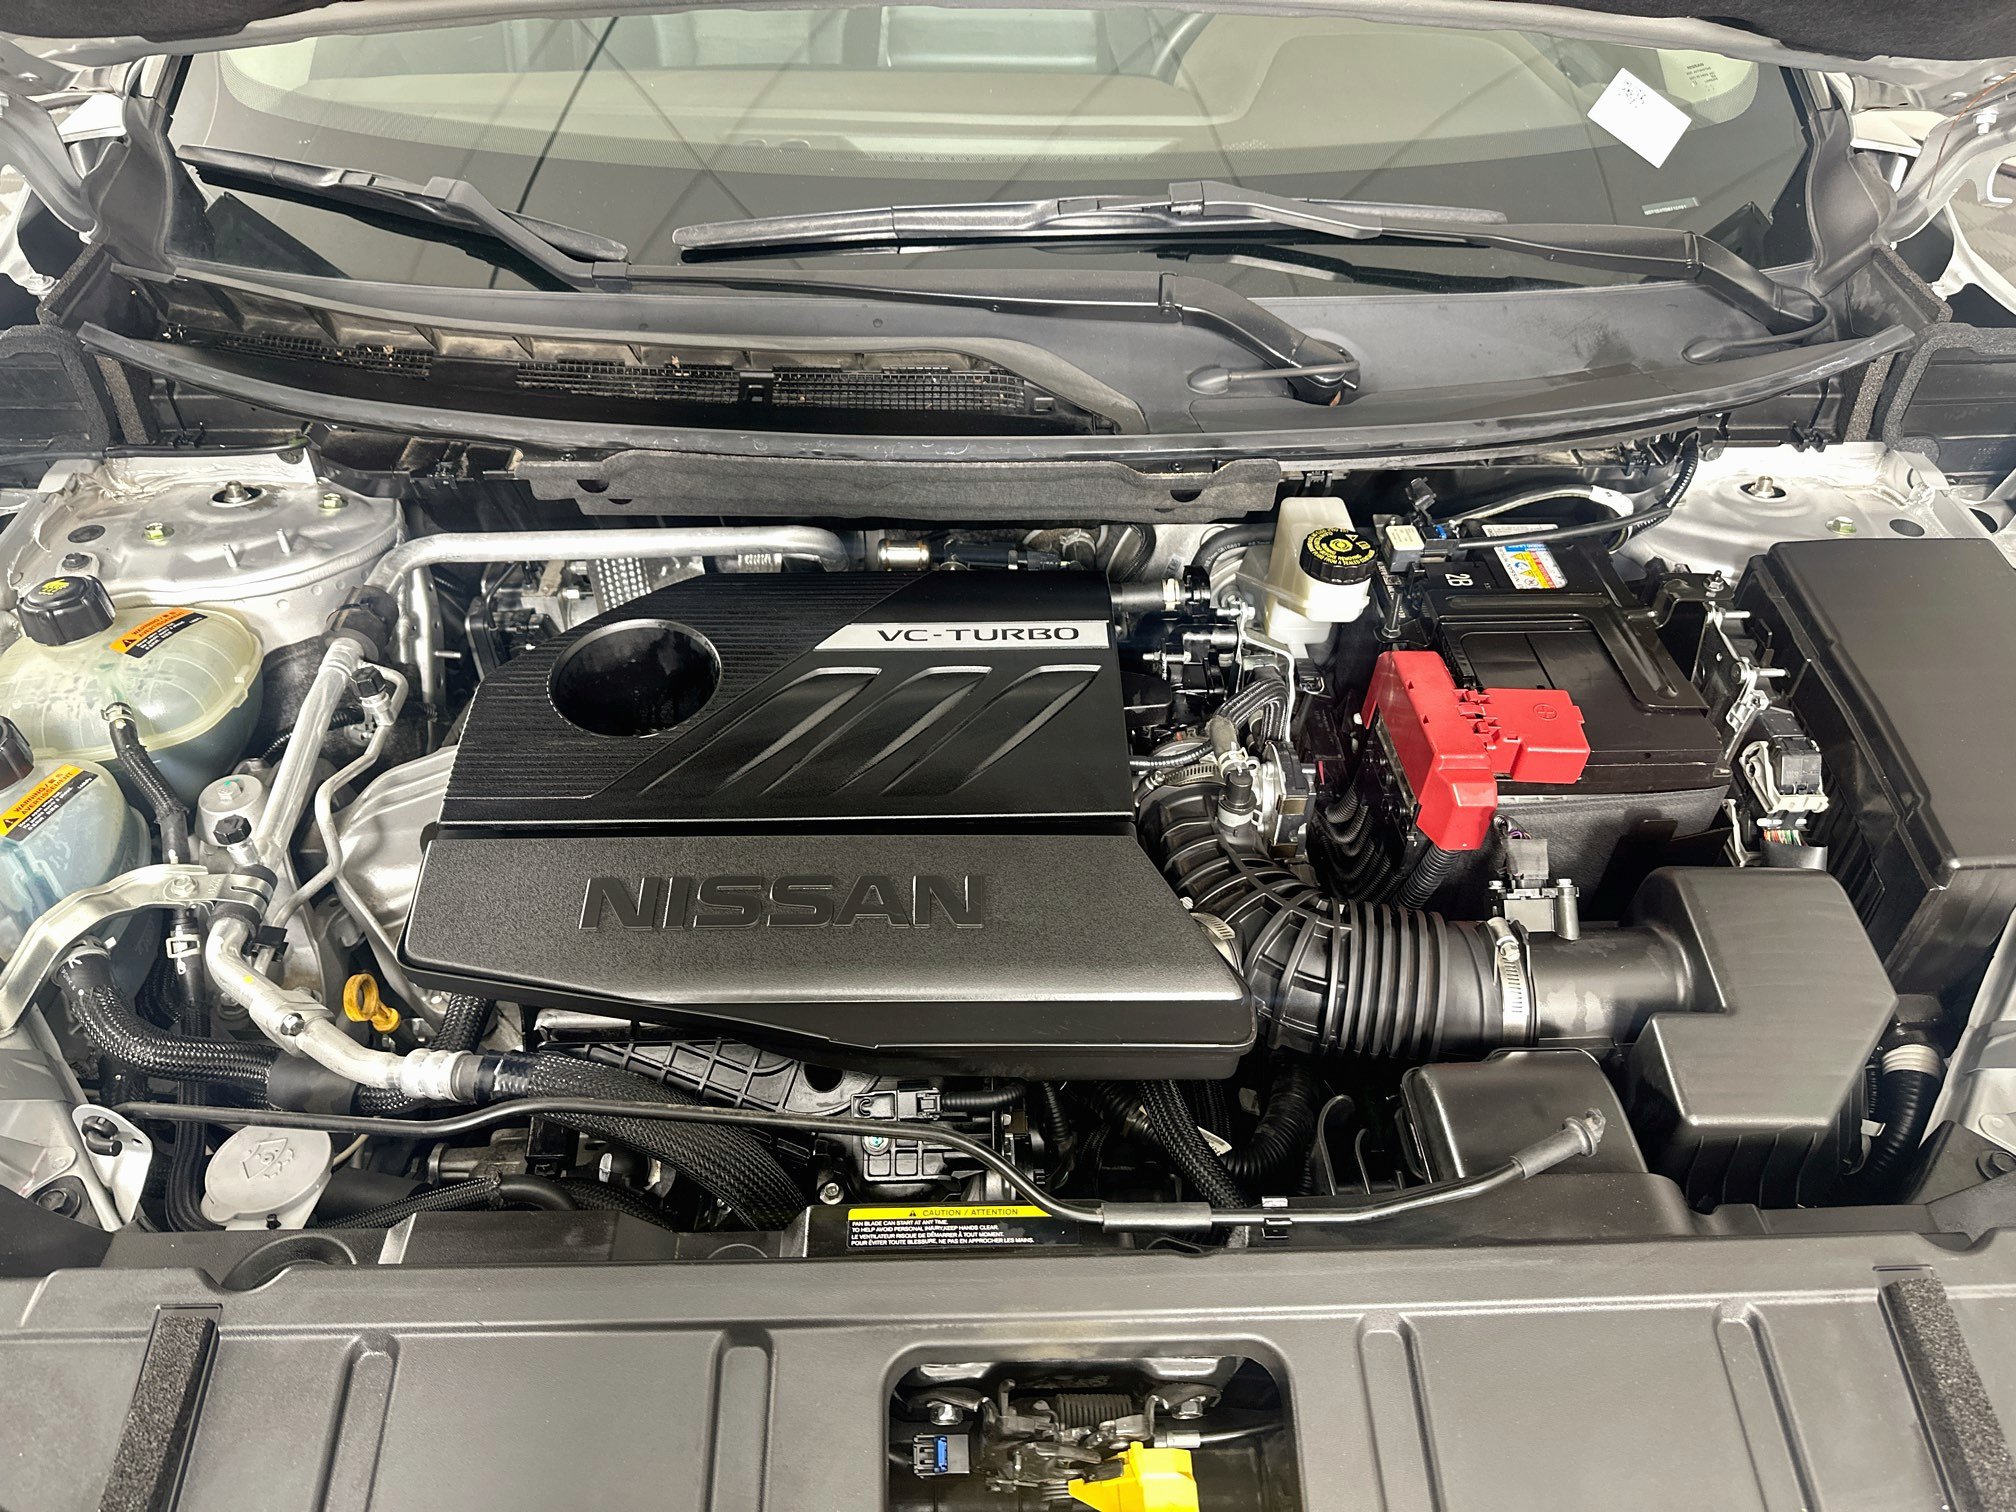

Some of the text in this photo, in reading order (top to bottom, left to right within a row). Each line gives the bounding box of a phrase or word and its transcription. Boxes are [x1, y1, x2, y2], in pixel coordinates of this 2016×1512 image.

[1444, 573, 1474, 587] 2B
[877, 627, 1080, 642] VC-TURBO
[578, 874, 984, 931] NISSAN
[922, 1208, 1018, 1217] CAUTION / ATTENTION
[868, 1238, 888, 1246] ÉVITER
